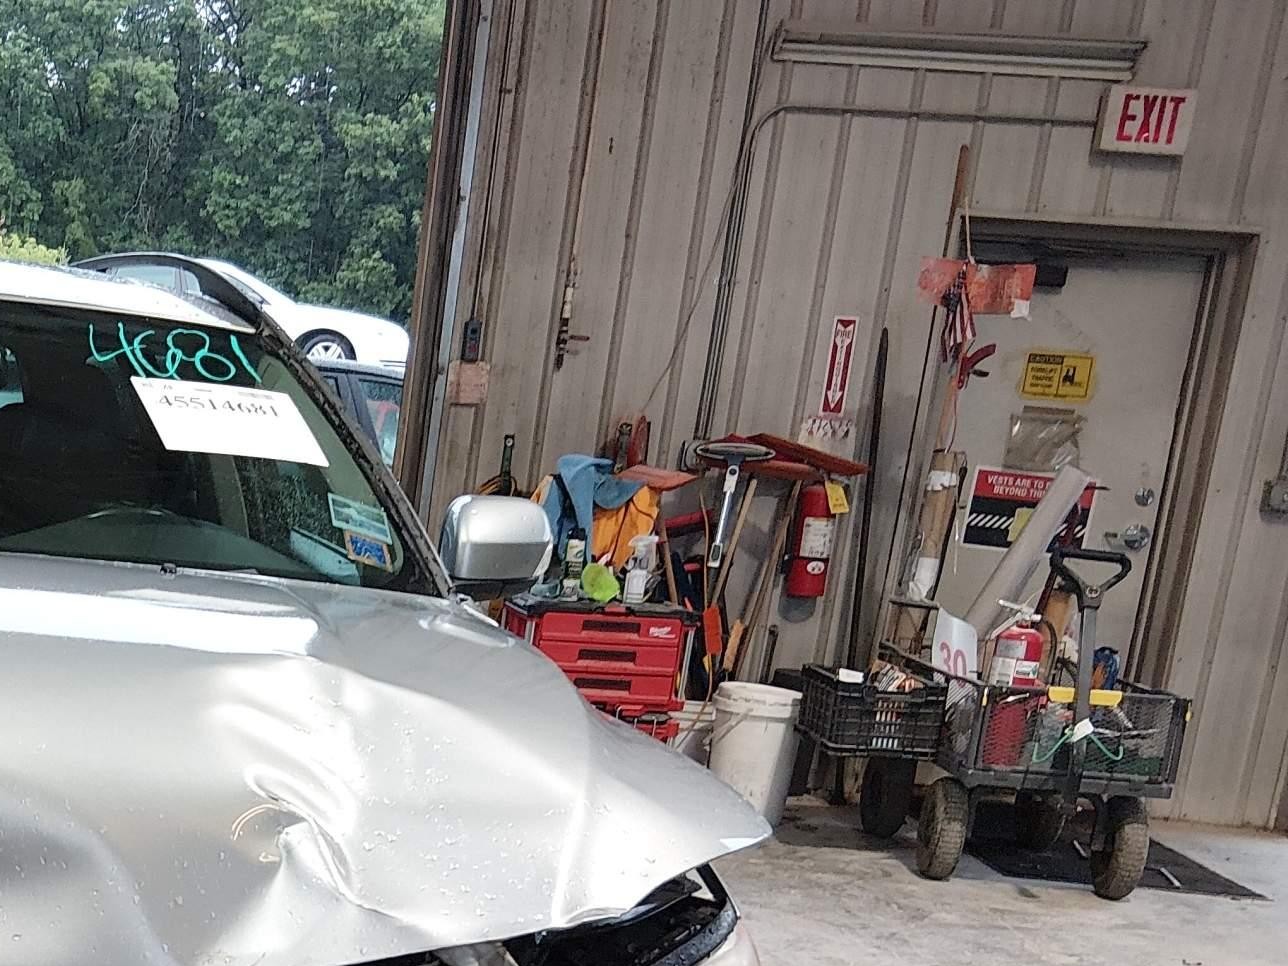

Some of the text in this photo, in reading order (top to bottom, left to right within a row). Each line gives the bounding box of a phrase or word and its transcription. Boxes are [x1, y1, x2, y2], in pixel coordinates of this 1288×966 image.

[1116, 93, 1186, 144] EXIT
[835, 328, 852, 339] FIRE
[89, 321, 262, 383] 4681
[159, 394, 278, 417] 45514681
[987, 475, 1014, 486] VESTS
[1015, 478, 1032, 488] ARE
[1033, 480, 1045, 490] TO
[993, 486, 1028, 497] BEYOND
